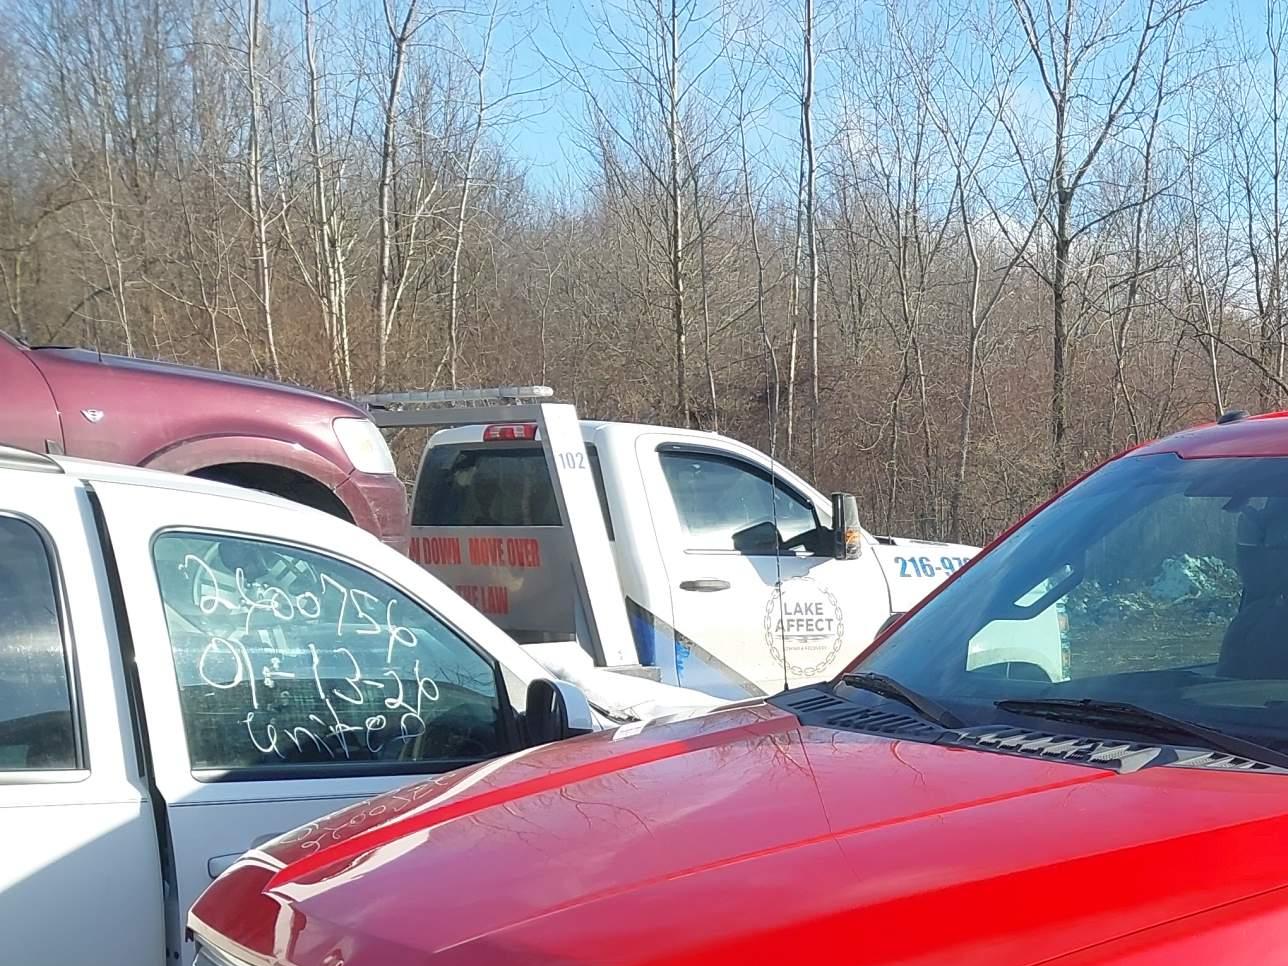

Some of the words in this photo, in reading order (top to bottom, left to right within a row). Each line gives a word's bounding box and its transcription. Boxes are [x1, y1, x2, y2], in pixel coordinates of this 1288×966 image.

[558, 451, 586, 470] 102
[422, 537, 462, 564] DOWN
[468, 537, 505, 565] MOVE
[506, 538, 540, 567] OVER
[480, 586, 509, 614] LAW
[783, 602, 824, 616] LAKE
[775, 618, 834, 632] AFFECT
